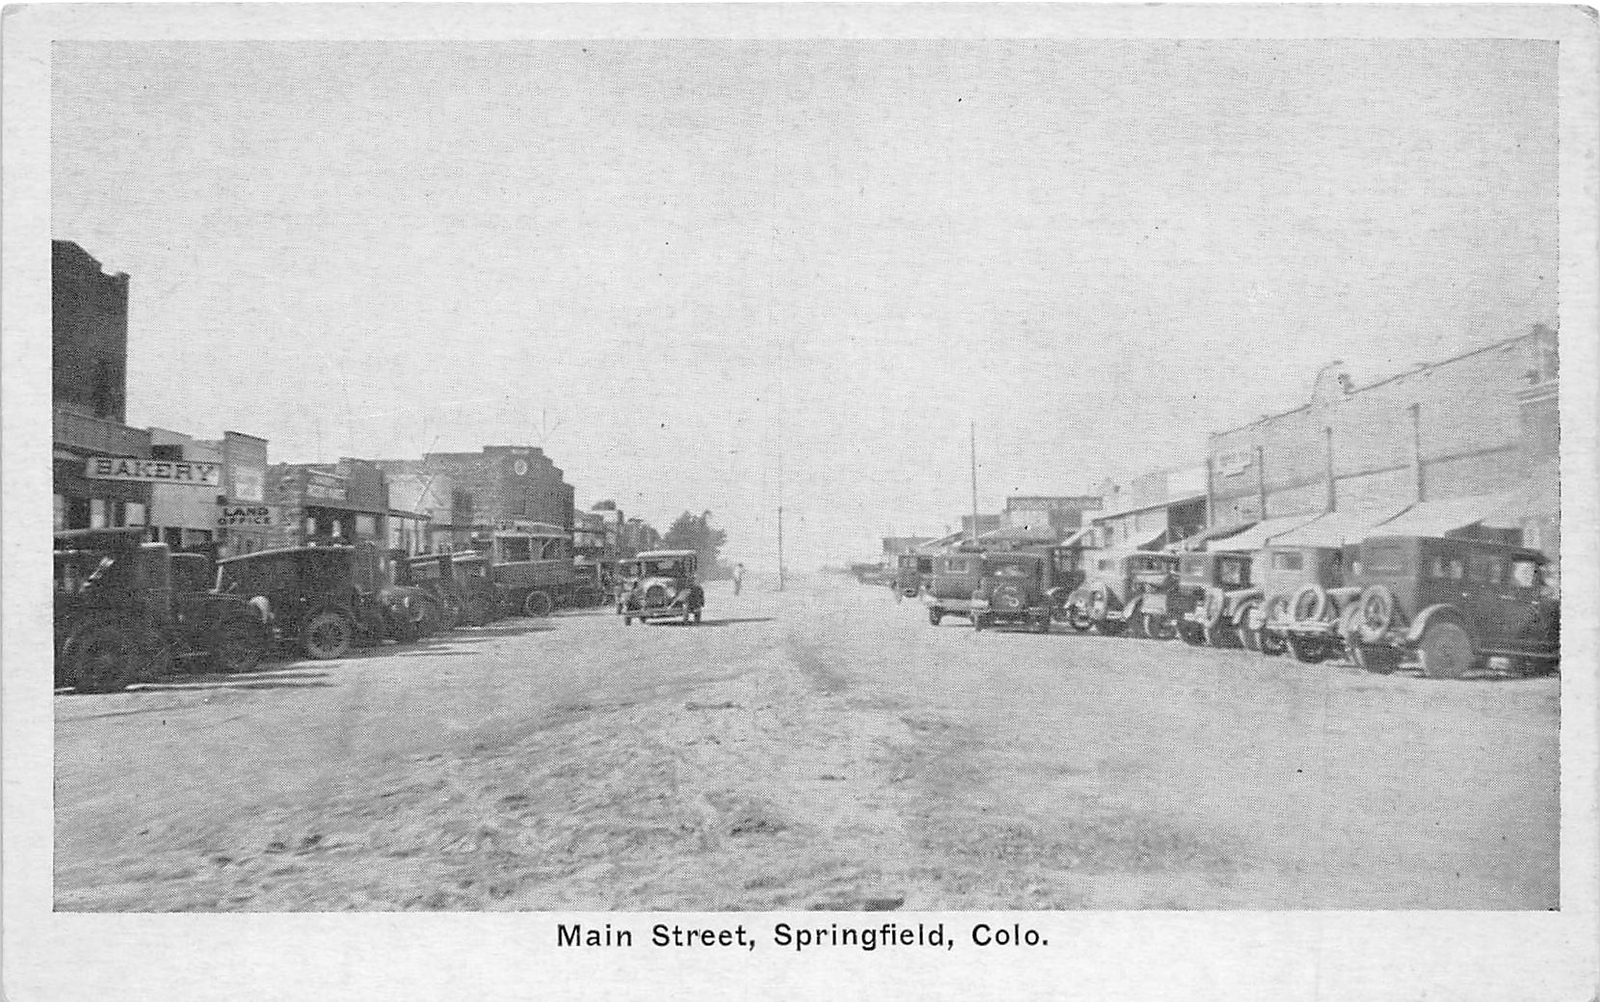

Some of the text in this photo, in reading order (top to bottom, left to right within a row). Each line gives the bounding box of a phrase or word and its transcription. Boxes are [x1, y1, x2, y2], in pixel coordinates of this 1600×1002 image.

[97, 458, 215, 482] BAKERY
[224, 507, 268, 517] LAND
[217, 517, 270, 525] OFFICE
